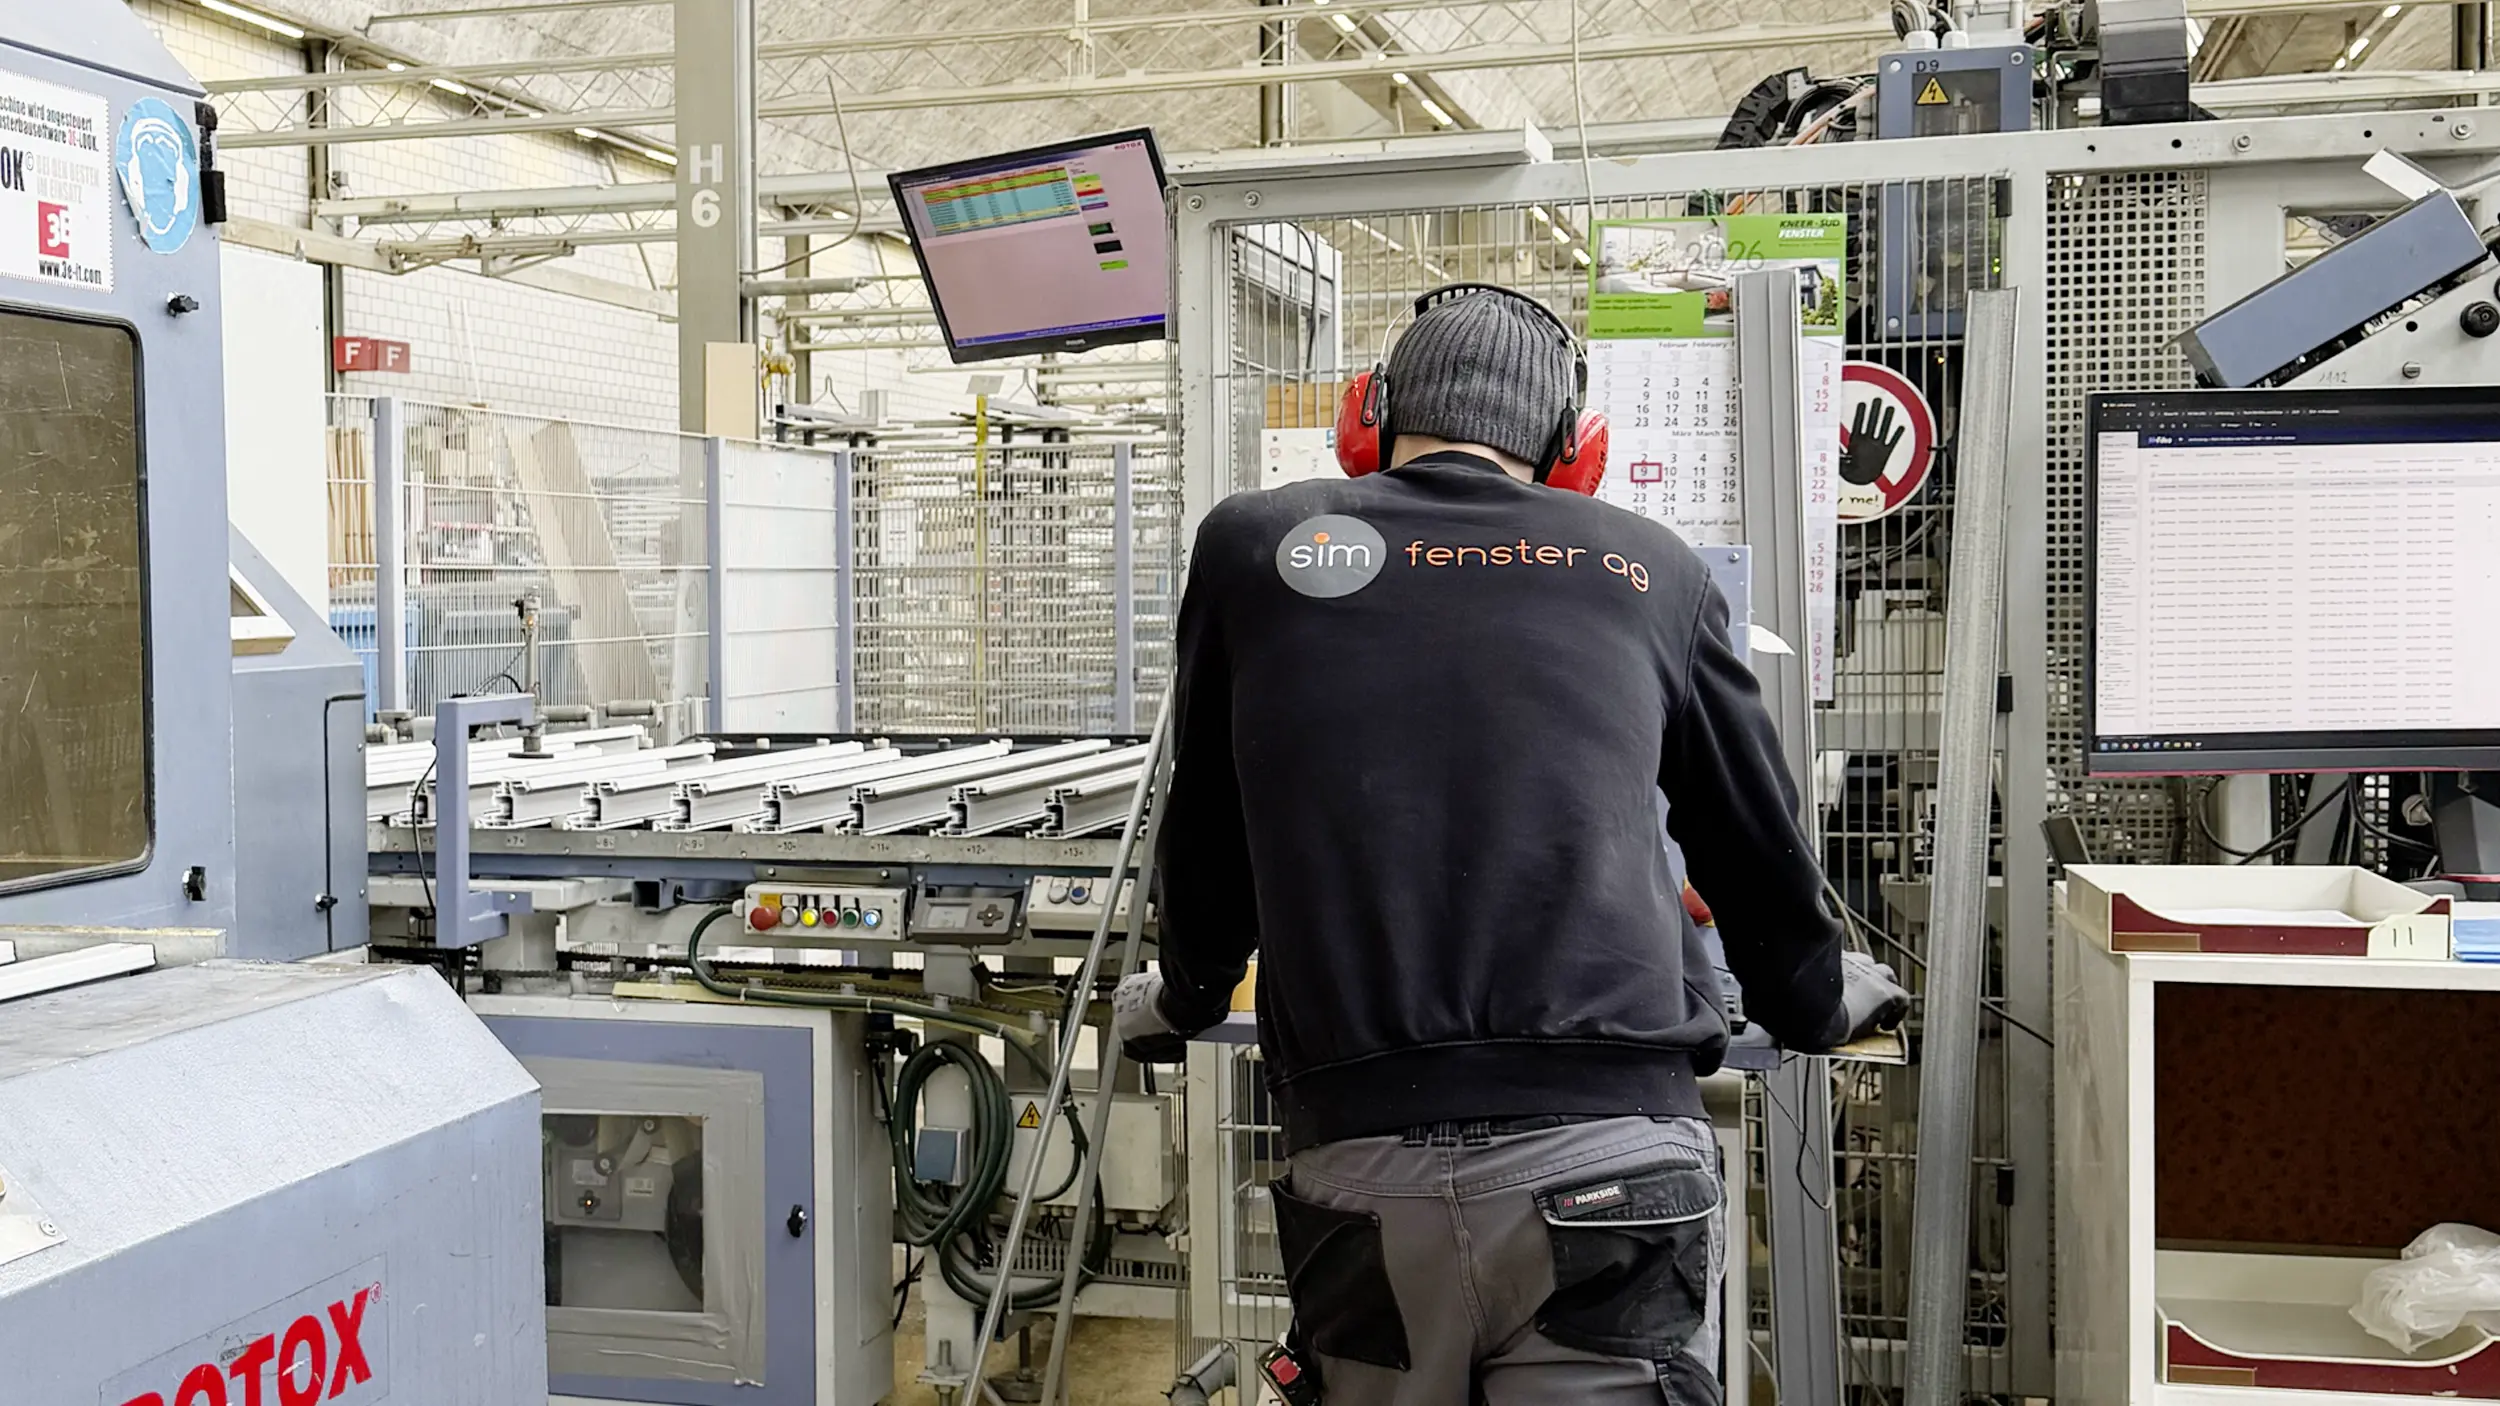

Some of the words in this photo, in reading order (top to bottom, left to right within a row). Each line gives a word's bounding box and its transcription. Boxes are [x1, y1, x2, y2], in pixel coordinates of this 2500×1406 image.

[28, 102, 45, 120] wird
[46, 107, 92, 132] angesteuert
[690, 144, 722, 184] H
[692, 189, 720, 228] 6
[1778, 228, 1824, 238] FENSTER
[1685, 240, 1765, 272] 2026
[39, 260, 102, 285] www.3e-it.com
[345, 342, 361, 365] F
[387, 346, 402, 367] F
[1824, 362, 1829, 372] 1
[1643, 377, 1651, 388] 2
[1672, 377, 1680, 388] 3
[1702, 377, 1710, 387] 4
[1822, 375, 1829, 386] 8
[1643, 391, 1650, 401] 9
[1666, 390, 1679, 401] 10
[1696, 390, 1708, 401] 11
[1816, 388, 1829, 399] 15
[1636, 404, 1650, 414] 16
[1665, 404, 1679, 414] 17
[1695, 404, 1708, 414] 18
[1814, 402, 1828, 412] 22
[1635, 417, 1649, 427] 23
[1664, 417, 1679, 427] 24
[1694, 417, 1708, 427] 25
[1723, 417, 1737, 427] 26
[1671, 453, 1678, 463] 3
[1699, 453, 1707, 463] 4
[1729, 453, 1737, 463] 5
[1820, 453, 1827, 462] 8
[1641, 467, 1648, 477] 9
[1664, 467, 1678, 477] 10
[1693, 467, 1706, 477] 11
[1723, 467, 1737, 477] 12
[1813, 467, 1827, 477] 15
[1664, 481, 1677, 490] 17
[1693, 481, 1706, 490] 18
[1723, 480, 1736, 490] 19
[1812, 480, 1826, 490] 22
[1633, 493, 1647, 503] 23
[1662, 493, 1676, 503] 24
[1692, 493, 1706, 503] 25
[1721, 493, 1736, 503] 26
[1812, 493, 1826, 503] 29
[1850, 494, 1879, 508] me!
[1662, 506, 1675, 516] 31
[1676, 519, 1695, 527] April
[1700, 519, 1718, 527] April
[1817, 542, 1824, 550] 5
[1290, 532, 1370, 568] sim
[1405, 538, 1586, 567] fenster
[1602, 553, 1648, 592] ag
[1811, 556, 1824, 567] 12
[1810, 569, 1823, 579] 19
[1809, 582, 1823, 593] 26
[1574, 1185, 1621, 1205] PARKSIDE
[121, 1288, 372, 1406] TOX
